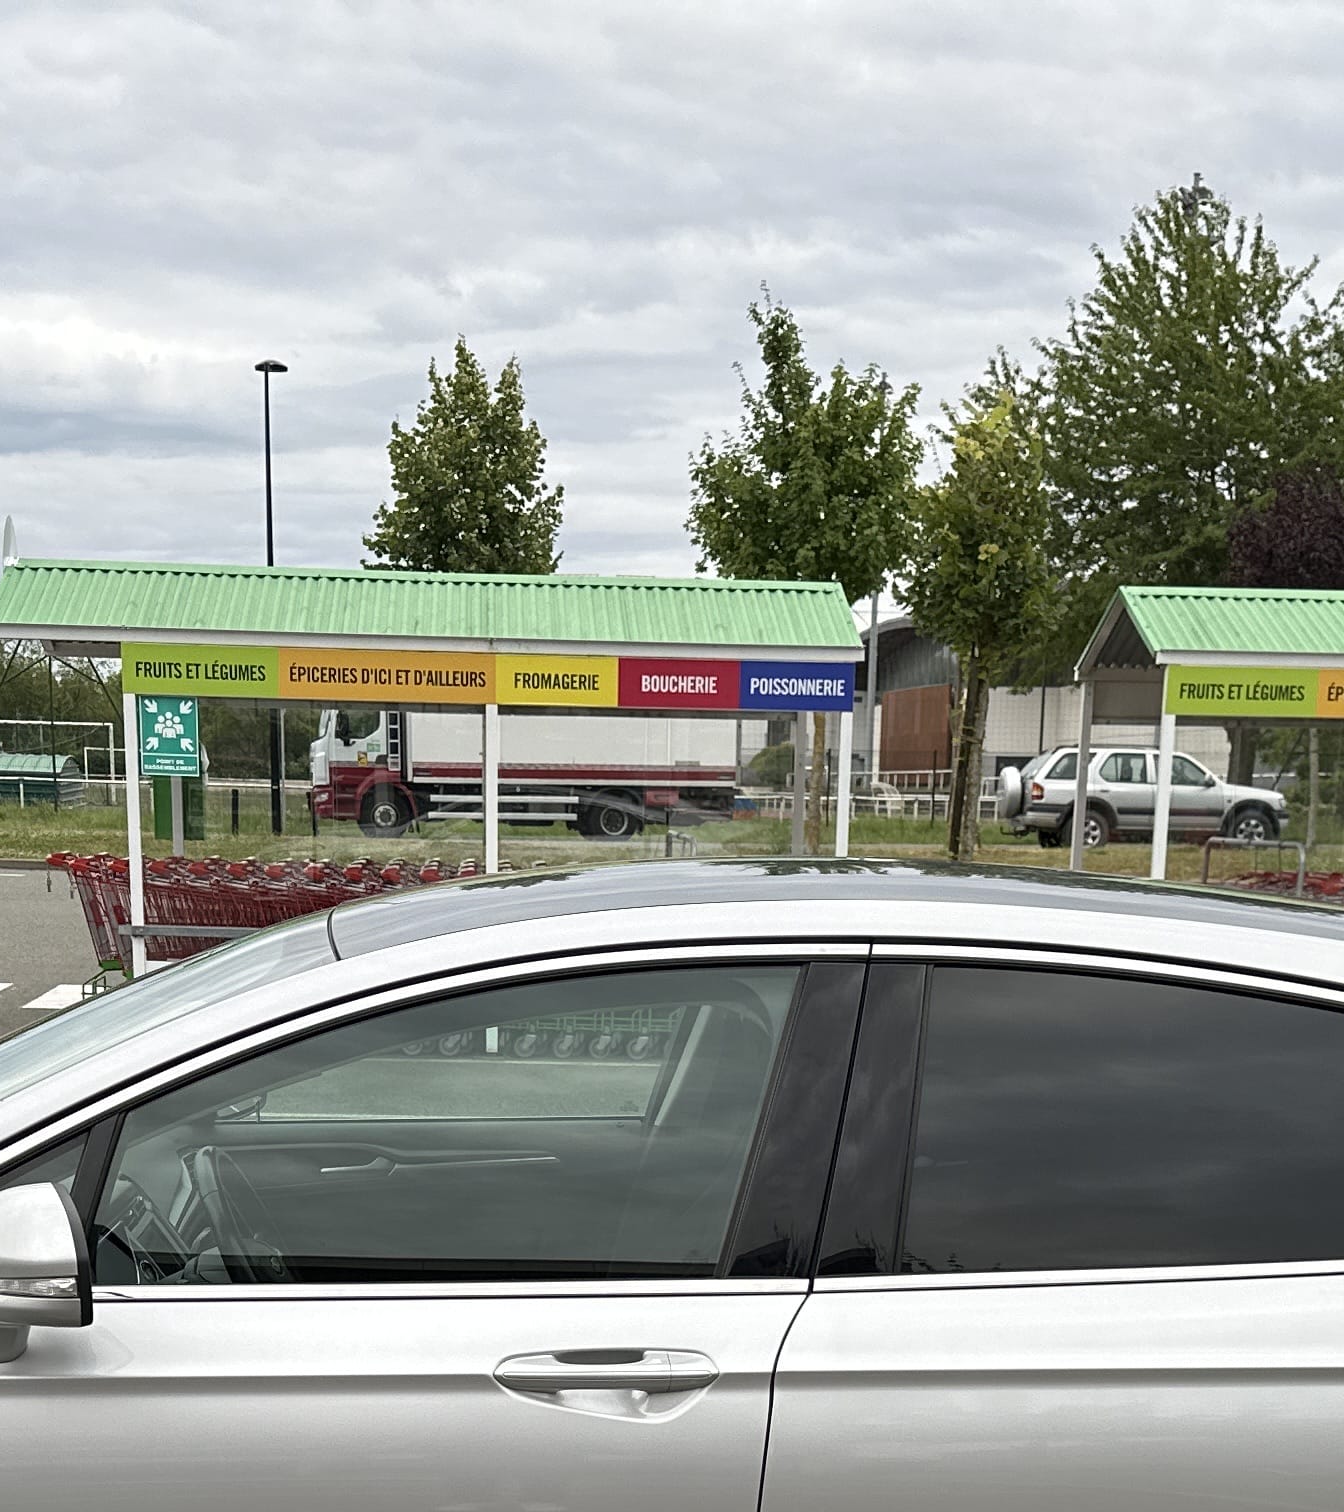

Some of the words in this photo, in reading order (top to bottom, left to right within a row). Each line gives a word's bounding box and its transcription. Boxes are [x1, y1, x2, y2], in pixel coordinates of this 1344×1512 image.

[135, 661, 182, 678] FRUITS
[185, 663, 201, 679] ET
[204, 660, 266, 681] LÉGUMES
[289, 663, 357, 683] ÉPICERIES
[361, 668, 391, 685] D'ICI
[395, 669, 410, 685] ET
[414, 670, 486, 687] D'AILLEURS
[514, 672, 599, 691] FROMAGERIE
[641, 674, 718, 694] BOUCHERIE
[749, 677, 846, 697] POISSONNERIE
[1179, 682, 1225, 700] FRUITS
[1228, 684, 1243, 700] ET
[1245, 680, 1305, 701] LÉGUMES
